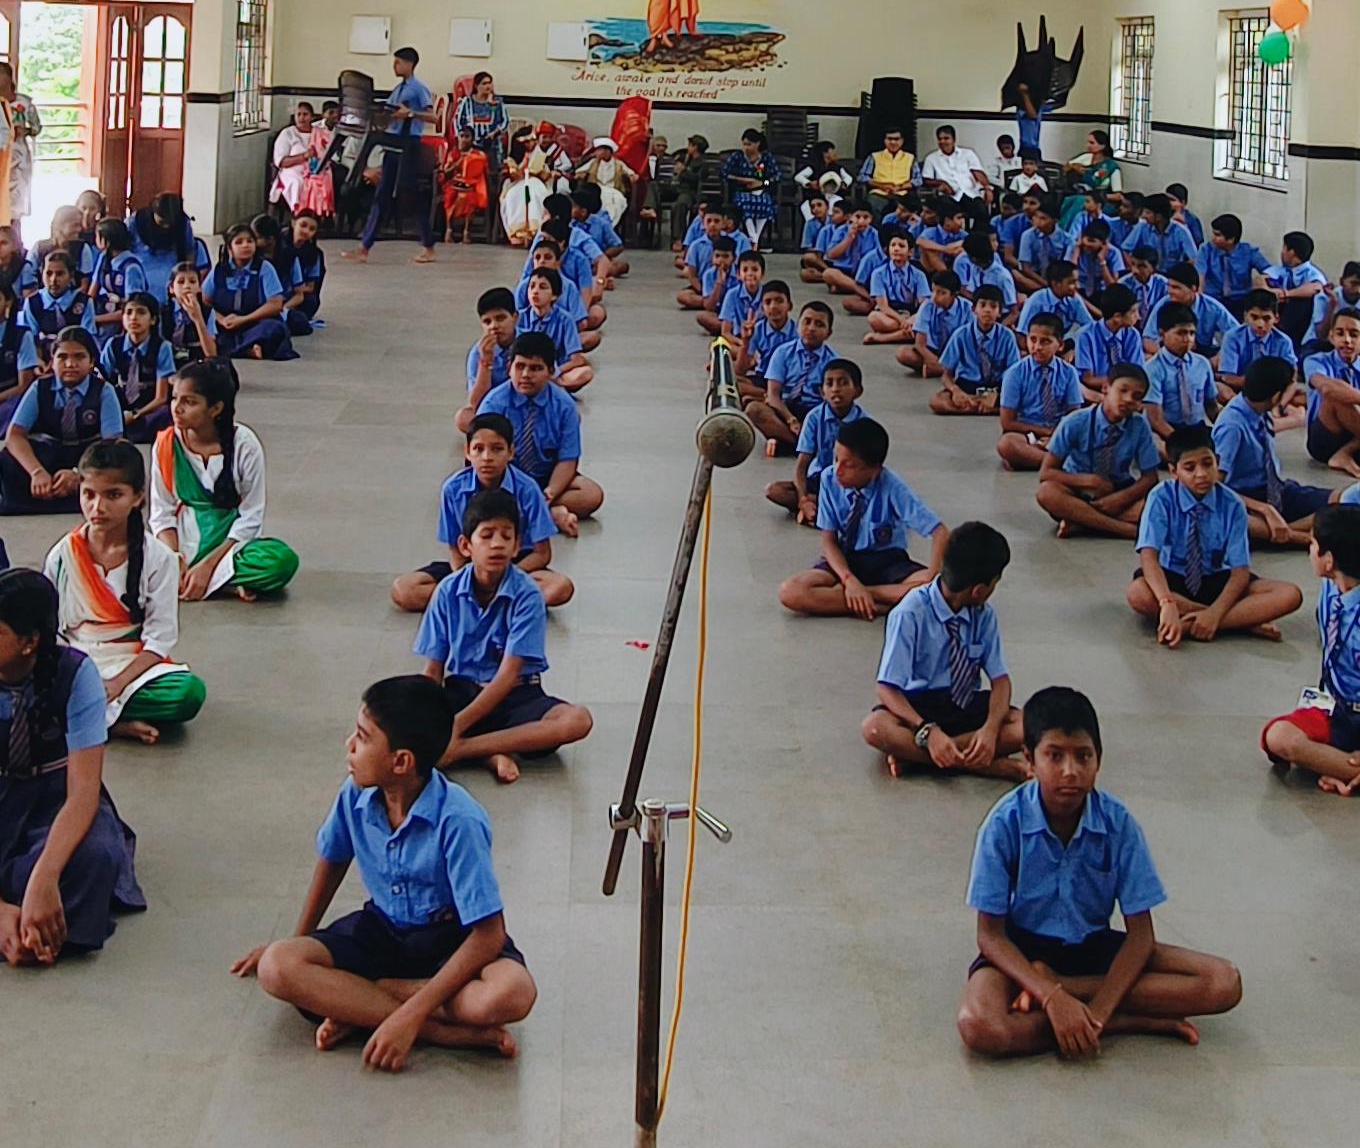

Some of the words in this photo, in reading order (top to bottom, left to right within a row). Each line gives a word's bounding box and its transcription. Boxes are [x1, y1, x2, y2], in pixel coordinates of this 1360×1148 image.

[615, 73, 651, 83] awake
[658, 74, 680, 84] and
[716, 77, 739, 88] stop
[741, 77, 766, 87] until
[616, 85, 632, 95] the
[636, 86, 660, 97] goal
[663, 86, 673, 97] is
